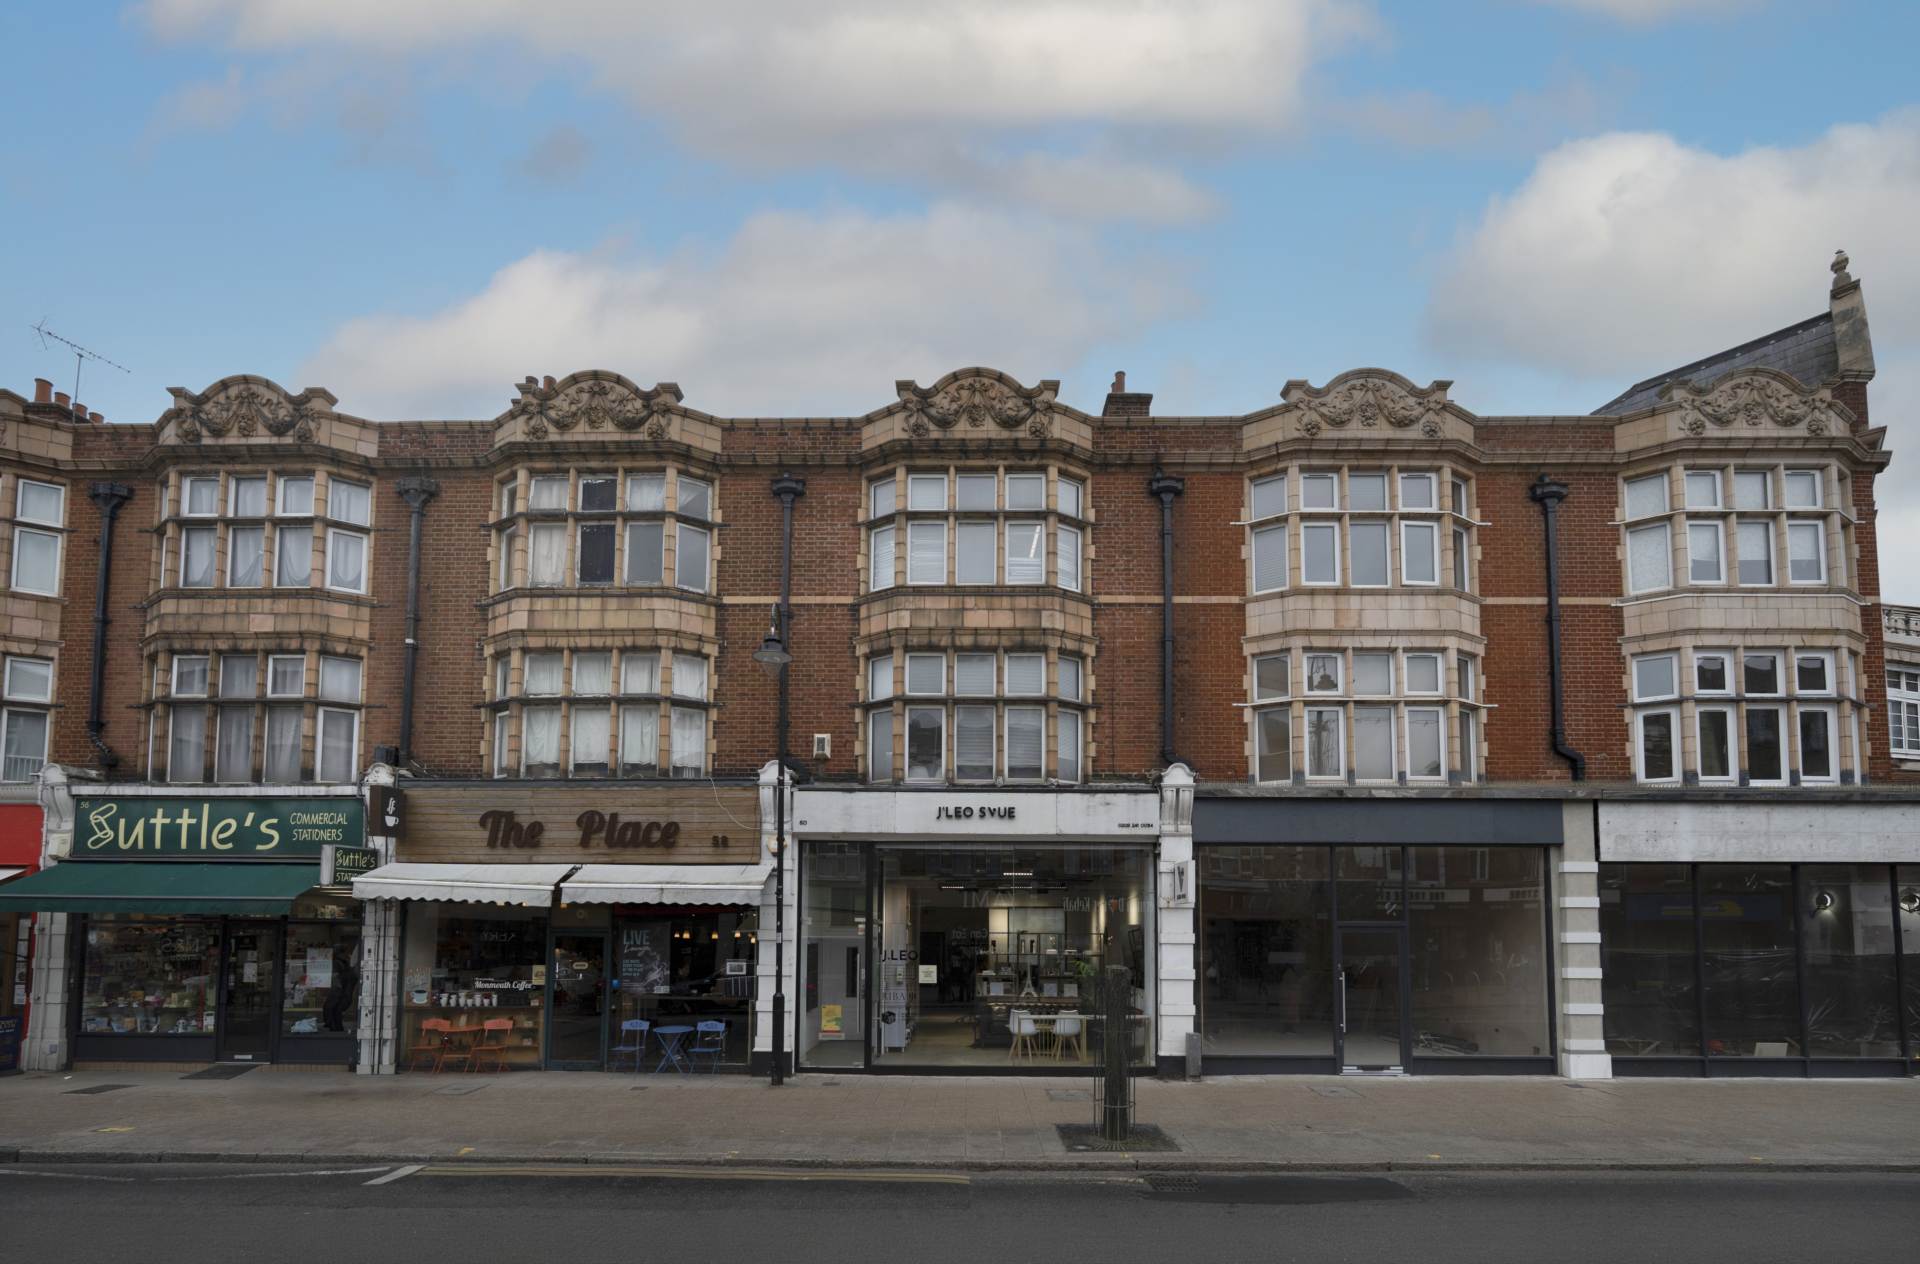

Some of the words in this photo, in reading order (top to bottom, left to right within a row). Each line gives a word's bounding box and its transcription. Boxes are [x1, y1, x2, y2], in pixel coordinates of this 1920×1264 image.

[289, 812, 348, 826] COMMERCIAL
[936, 806, 974, 820] J'LEO
[87, 803, 281, 850] Suttle's
[479, 809, 545, 848] The
[575, 809, 680, 848] Place
[292, 828, 343, 841] STATIONERS
[335, 849, 377, 868] Suttle's
[623, 929, 650, 945] LIVE
[882, 950, 918, 961] J.LEO
